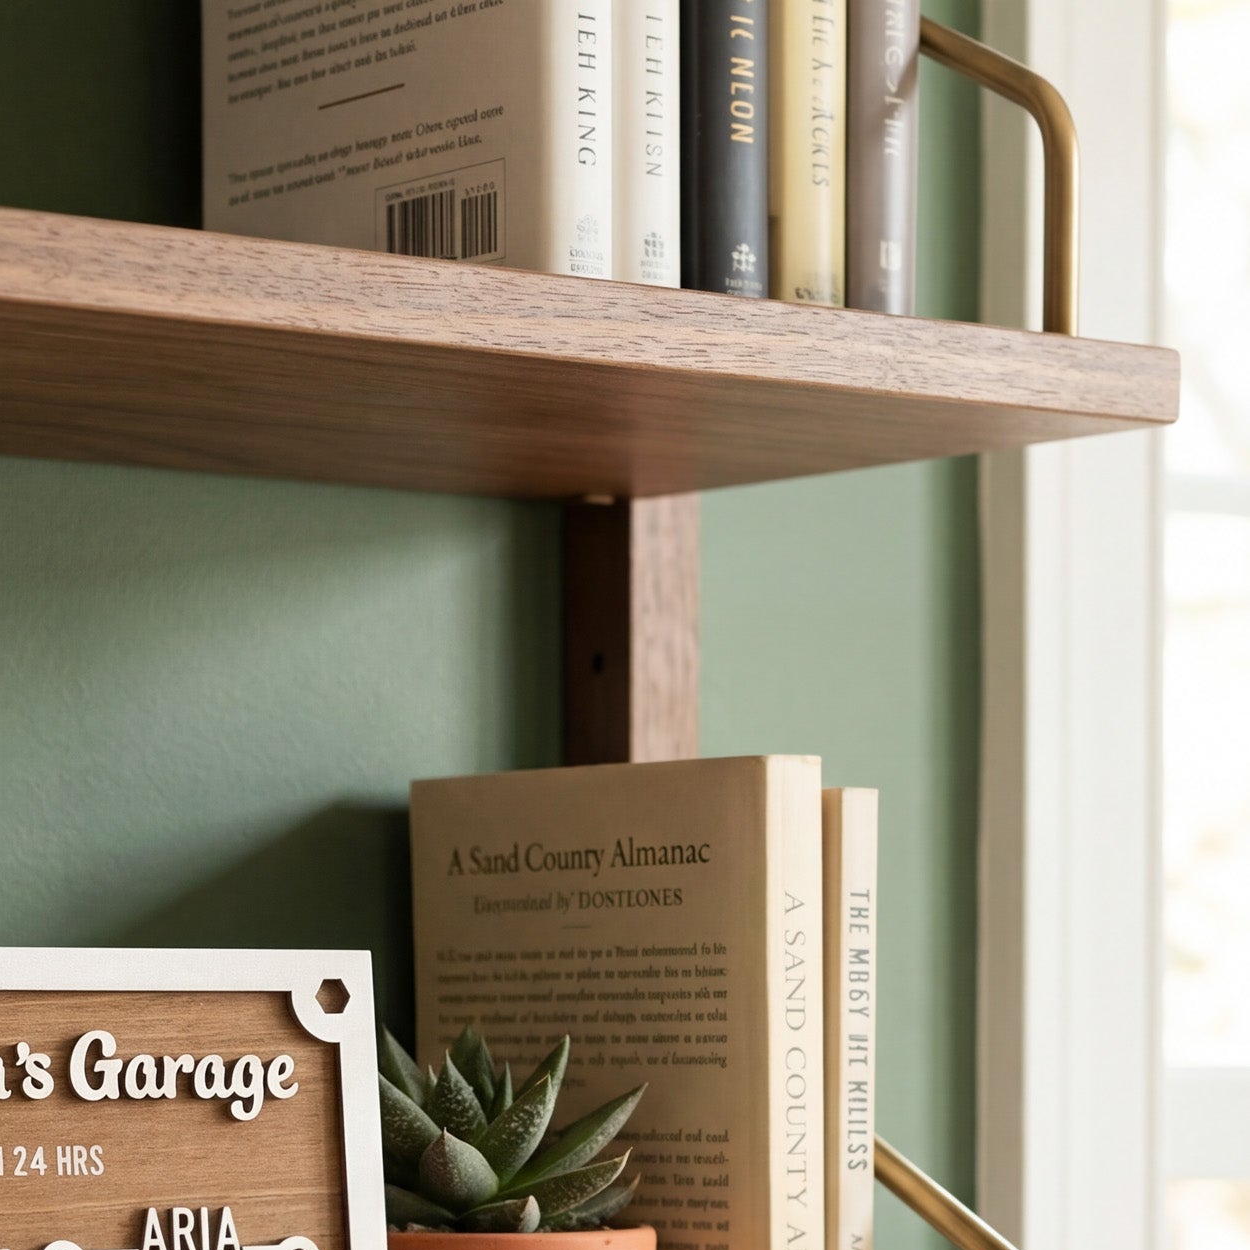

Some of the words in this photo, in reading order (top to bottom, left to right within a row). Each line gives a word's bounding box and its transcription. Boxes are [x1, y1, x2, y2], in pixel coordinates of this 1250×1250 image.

[577, 85, 597, 167] KING
[447, 848, 465, 876] A
[469, 842, 520, 875] Sand
[610, 836, 711, 868] Almanac
[784, 890, 806, 914] A
[784, 928, 807, 1032] SAND
[68, 1028, 299, 1122] Garage
[13, 1146, 47, 1177] 24
[55, 1145, 105, 1177] HRS
[784, 1046, 808, 1209] COUNTY
